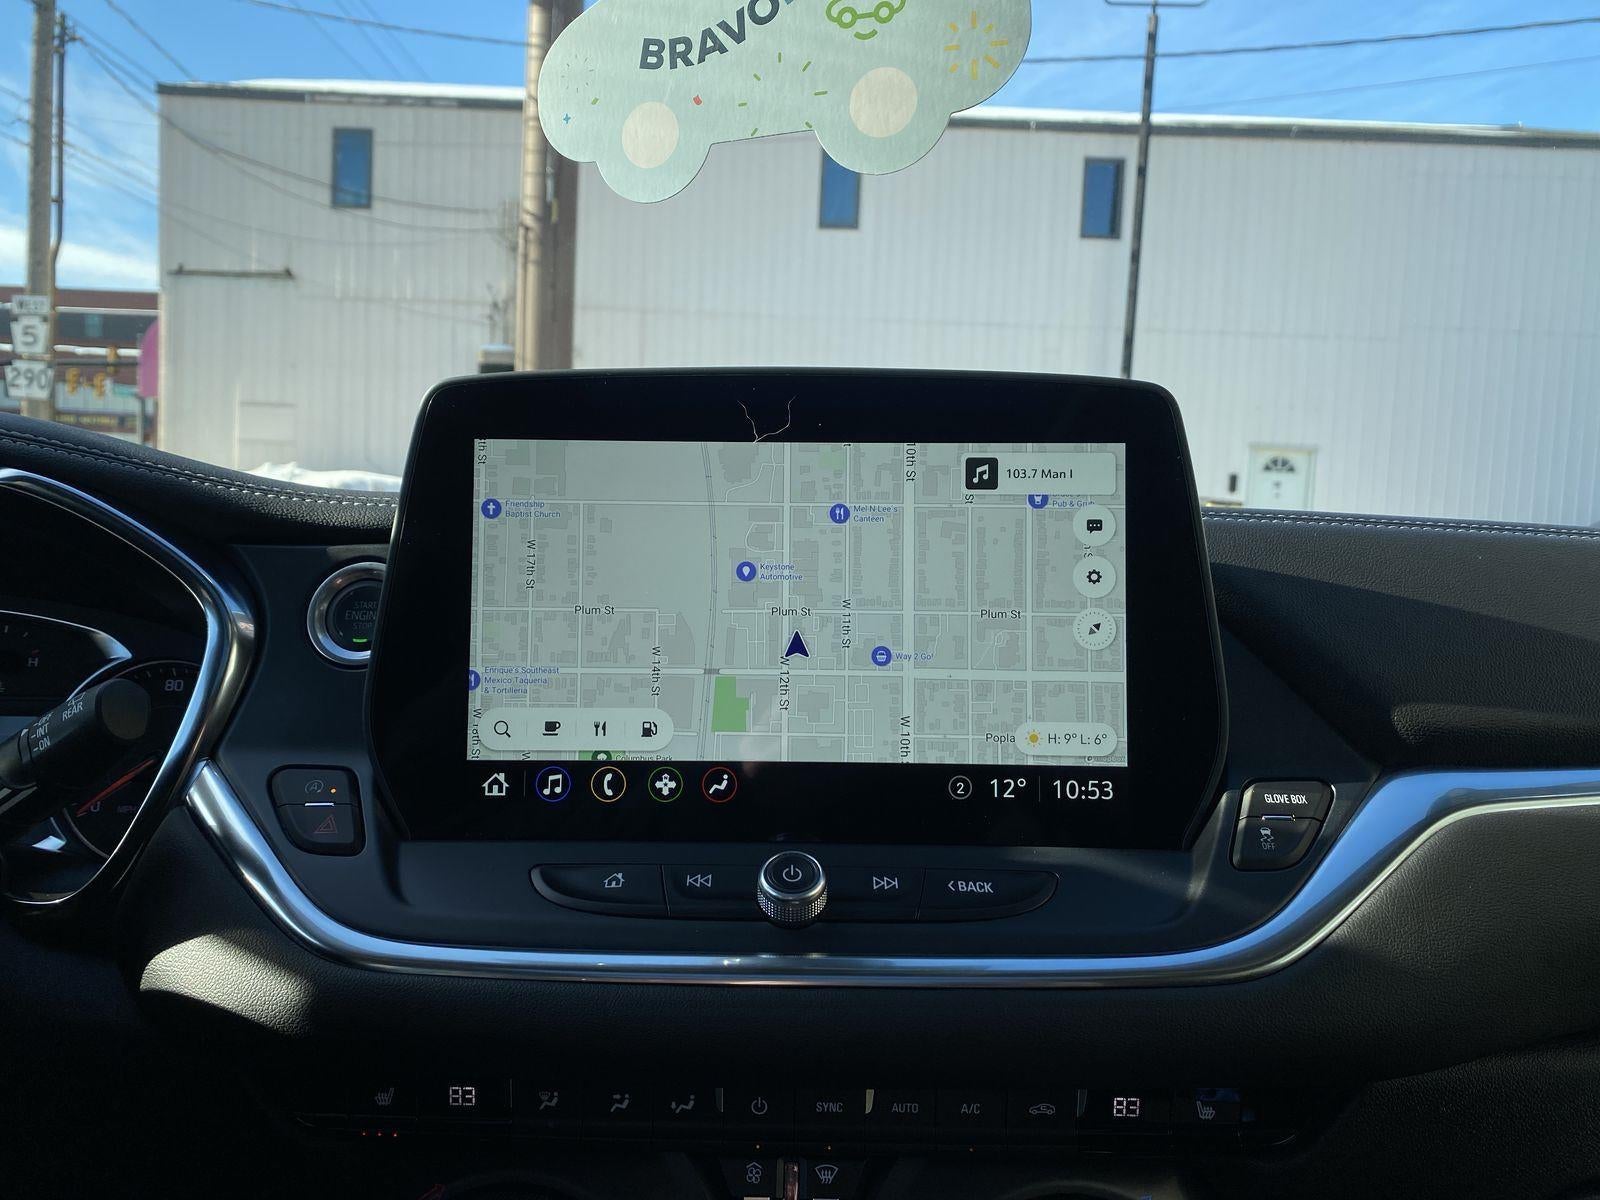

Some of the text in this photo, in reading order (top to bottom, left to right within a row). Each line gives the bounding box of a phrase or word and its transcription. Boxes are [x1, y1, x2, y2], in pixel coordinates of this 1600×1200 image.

[639, 0, 793, 70] BRAVO
[21, 325, 37, 346] 5
[8, 367, 49, 389] 290
[477, 454, 487, 465] St
[905, 470, 917, 482] St
[1006, 468, 1038, 479] 103.7
[1040, 468, 1066, 479] Man
[505, 500, 545, 508] Friendship
[965, 493, 974, 505] St
[1052, 500, 1068, 508] Pub
[1069, 500, 1075, 508] &
[505, 510, 561, 518] Baptist Church
[853, 514, 885, 523] Canteen
[526, 539, 536, 590] W 17th St
[760, 563, 795, 572] Keystone
[760, 573, 803, 581] Automotive
[574, 605, 615, 616] Plum St
[771, 606, 812, 617] Plum St
[980, 609, 1022, 619] Plum St
[842, 598, 851, 649] W 11th St
[895, 652, 912, 662] Way
[484, 666, 560, 675] Enrique's Southeast
[650, 645, 661, 697] W 14th St
[165, 680, 184, 692] 80
[484, 676, 512, 684] Mexico
[779, 655, 790, 711] W 12th St
[483, 686, 490, 694] &
[62, 702, 83, 721] REAR
[473, 708, 482, 719] W
[900, 715, 911, 728] W
[36, 722, 50, 738] INT
[38, 736, 51, 751] ON
[1048, 732, 1108, 745] H: 9° L: 6°
[900, 732, 911, 758] 10th
[471, 748, 481, 760] St
[956, 782, 965, 794] 2
[990, 778, 1027, 798] 12°
[1053, 779, 1114, 800] 10:53
[1264, 793, 1309, 805] GLOVE BOX
[1261, 842, 1276, 851] OFF
[957, 878, 994, 894] BACK
[449, 1086, 475, 1106] 83
[815, 1101, 843, 1113] SYNC
[891, 1102, 919, 1114] AUTO
[960, 1103, 981, 1115] A/C
[1113, 1097, 1140, 1117] 83
